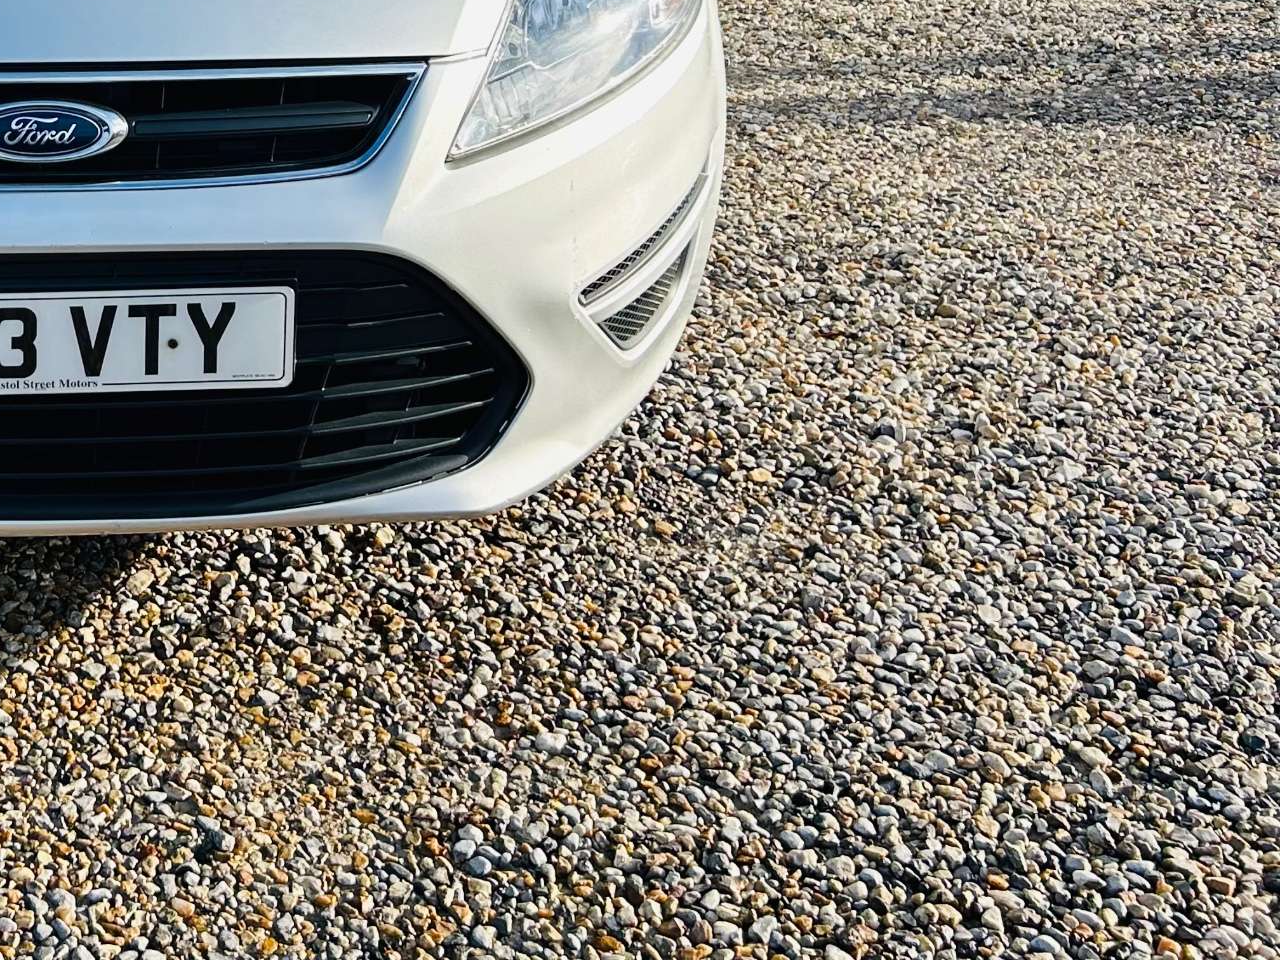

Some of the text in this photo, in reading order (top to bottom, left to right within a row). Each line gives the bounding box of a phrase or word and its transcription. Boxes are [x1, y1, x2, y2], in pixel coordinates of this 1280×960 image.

[4, 116, 76, 145] Ford
[69, 301, 236, 377] VTY
[22, 379, 56, 391] Street
[59, 378, 99, 388] Motors
